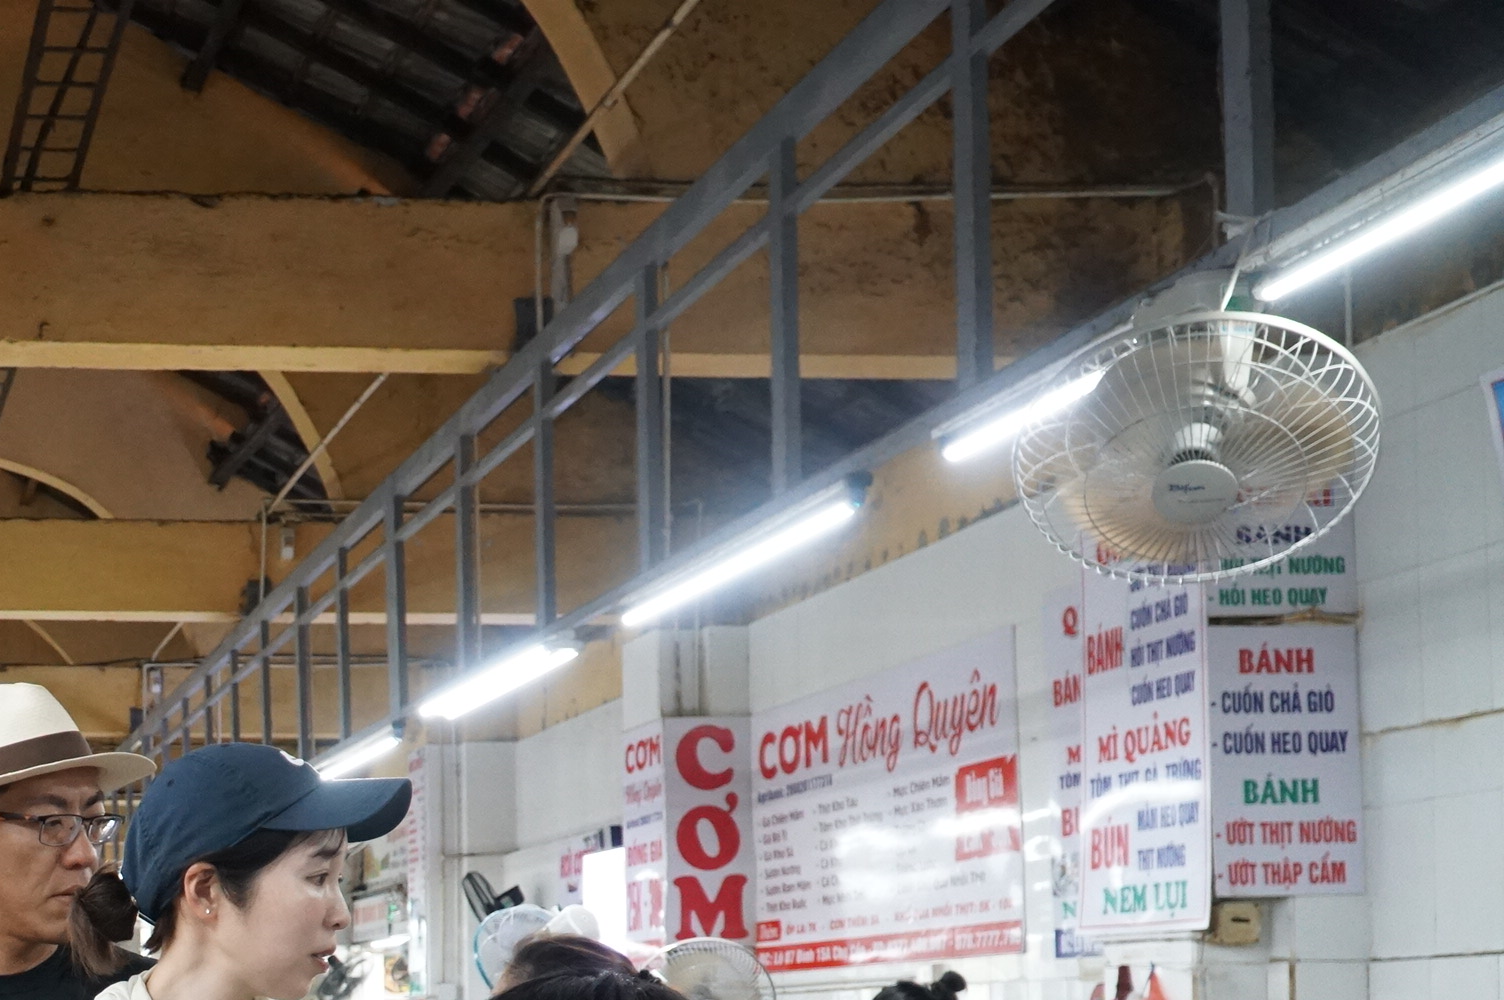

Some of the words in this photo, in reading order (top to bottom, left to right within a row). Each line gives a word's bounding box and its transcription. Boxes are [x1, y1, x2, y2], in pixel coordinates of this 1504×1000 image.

[1288, 554, 1345, 575] NƯỚNG
[1219, 581, 1246, 606] HỎI
[1251, 588, 1283, 606] HEO
[1287, 587, 1328, 606] QUAY
[1087, 622, 1124, 676] BÁNH
[1238, 641, 1315, 674] BÁNH
[1053, 670, 1082, 708] BÁN
[1156, 676, 1173, 699] HEO
[1175, 670, 1196, 697] QUAY
[1221, 682, 1264, 714] CUỐN
[1269, 682, 1302, 714] CHẢ
[1307, 683, 1335, 714] GIÒ
[758, 715, 830, 780] CƠM
[836, 693, 902, 773] Hồng
[913, 667, 999, 757] Quyên
[1098, 725, 1119, 764] MÌ
[1123, 710, 1192, 764] QUẢNG
[1222, 723, 1265, 754] CUỐN
[1271, 731, 1302, 754] HEO
[1307, 731, 1348, 756] QUAY
[625, 735, 662, 774] CƠM
[1090, 774, 1113, 798] TÔM
[1243, 772, 1319, 804] BÁNH
[673, 724, 749, 940] CƠM
[1091, 815, 1130, 870] BÚN
[1225, 818, 1256, 845] ƯỚT
[1260, 821, 1293, 850] THỊT
[1299, 815, 1357, 844] NƯỚNG
[1228, 857, 1257, 886] ƯỚT
[1261, 856, 1303, 890] THẬP
[1102, 885, 1148, 915] NEM
[1154, 880, 1188, 918] LỤI
